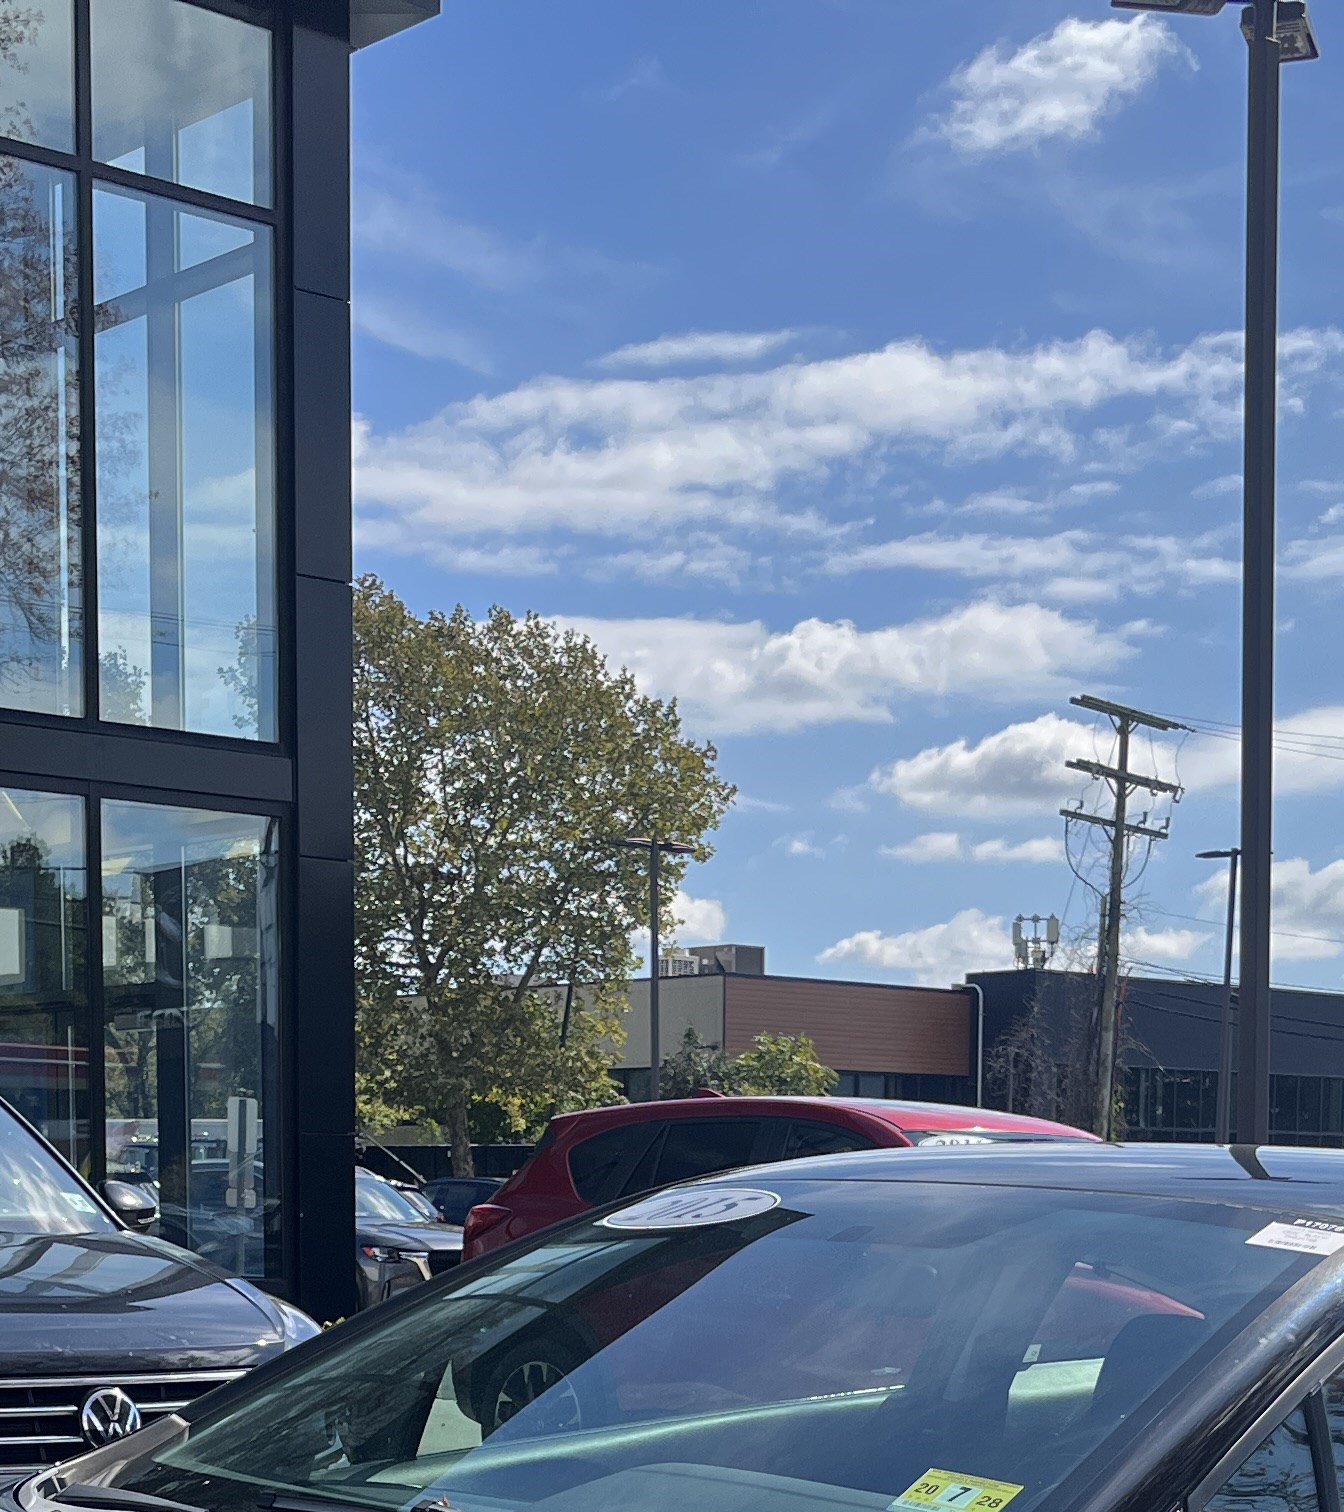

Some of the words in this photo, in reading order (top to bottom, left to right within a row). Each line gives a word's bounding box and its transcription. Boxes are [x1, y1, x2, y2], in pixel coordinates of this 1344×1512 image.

[915, 1482, 940, 1495] 20
[947, 1486, 973, 1502] 7
[976, 1495, 1004, 1509] 28
